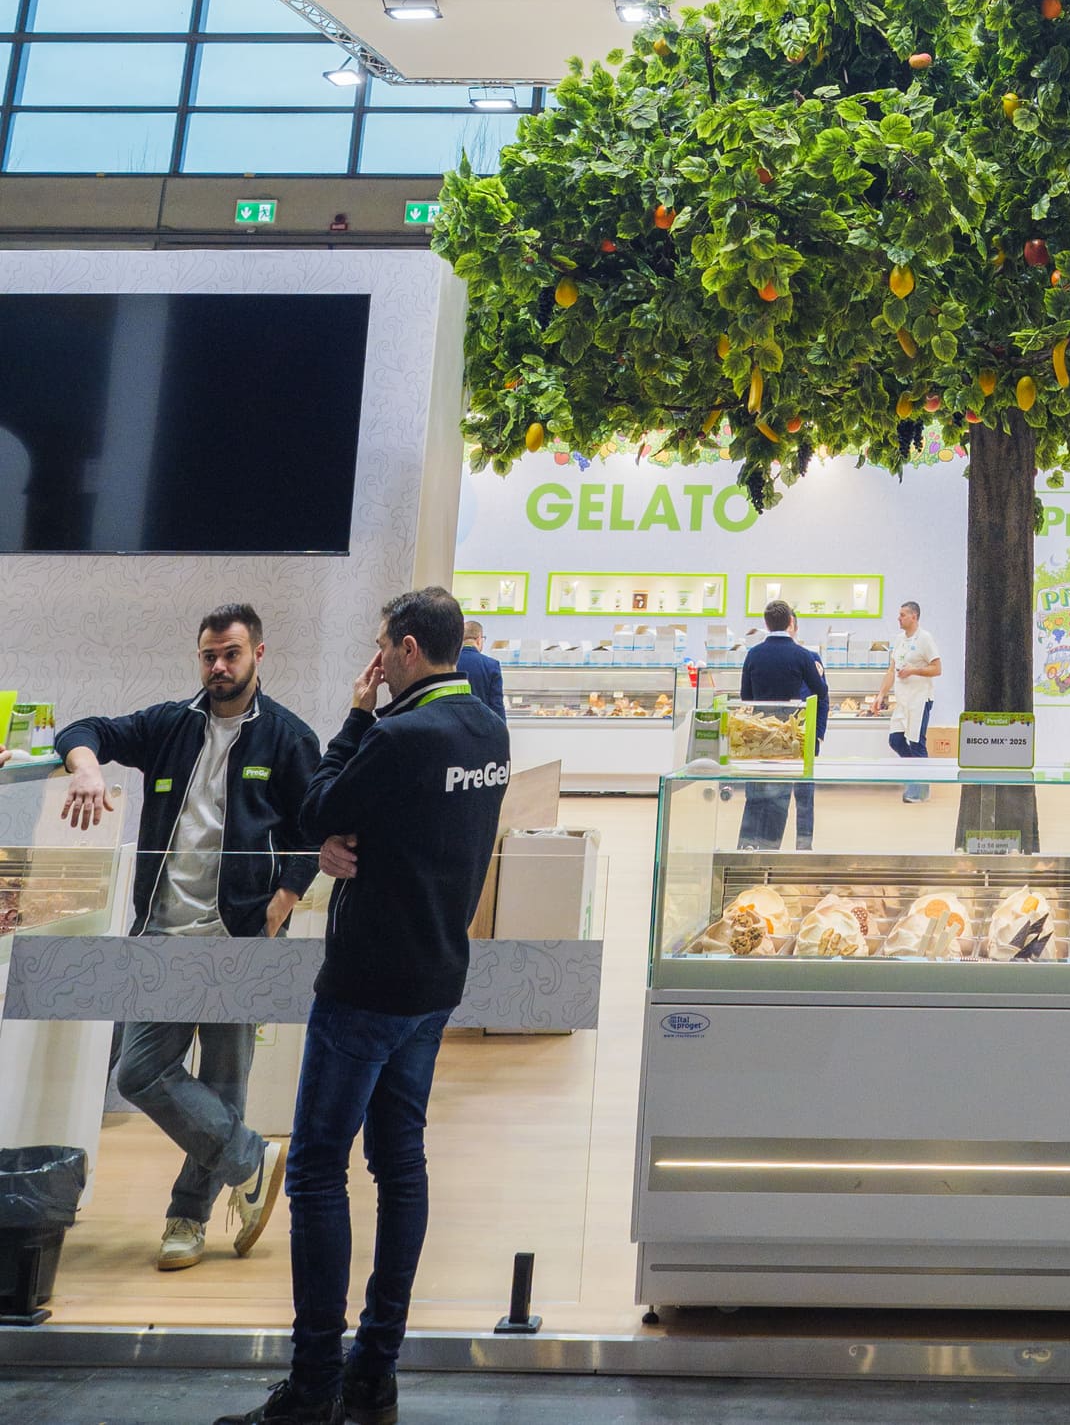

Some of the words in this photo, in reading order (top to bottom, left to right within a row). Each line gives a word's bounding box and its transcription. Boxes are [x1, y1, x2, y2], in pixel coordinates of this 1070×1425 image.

[525, 482, 760, 533] GELATO
[966, 737, 989, 745] BISCO
[1009, 738, 1027, 746] 2025
[445, 760, 511, 792] PreGel
